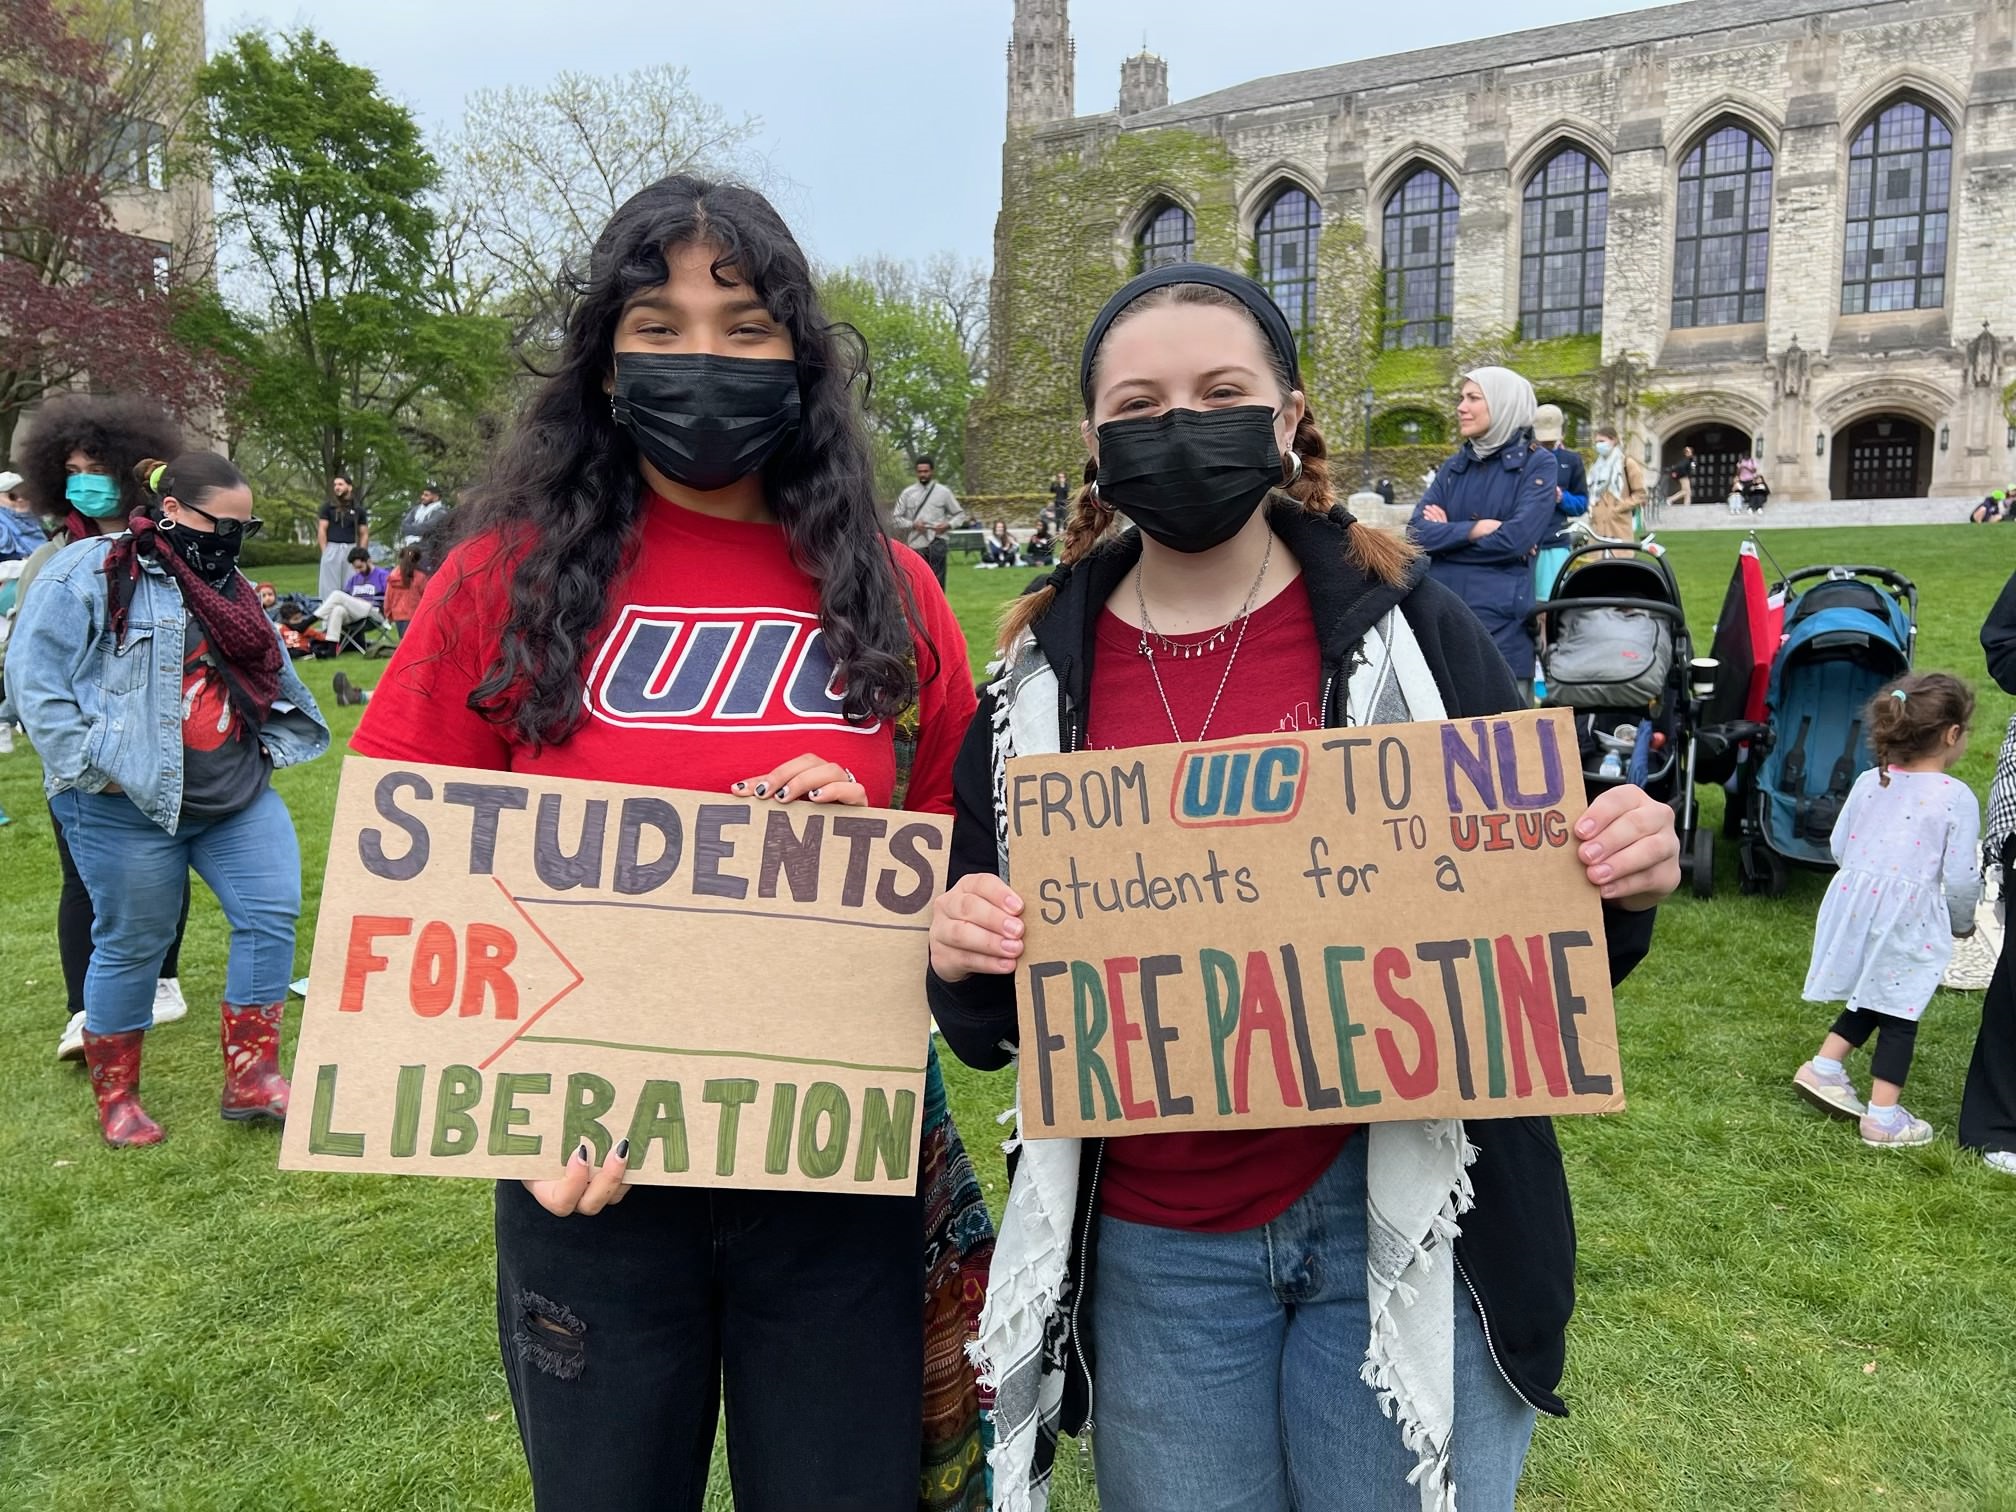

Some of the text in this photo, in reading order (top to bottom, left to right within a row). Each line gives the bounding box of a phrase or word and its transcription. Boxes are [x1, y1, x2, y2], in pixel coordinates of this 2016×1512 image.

[1013, 718, 1566, 837] FROM UIC TO NU
[1382, 810, 1569, 852] TO UIUC
[358, 771, 945, 915] STUDENTS
[1039, 835, 1466, 925] students for a
[338, 914, 520, 1021] FOR
[1028, 930, 1614, 1127] FREE PALESTINE
[308, 1063, 916, 1183] LIBERATION
